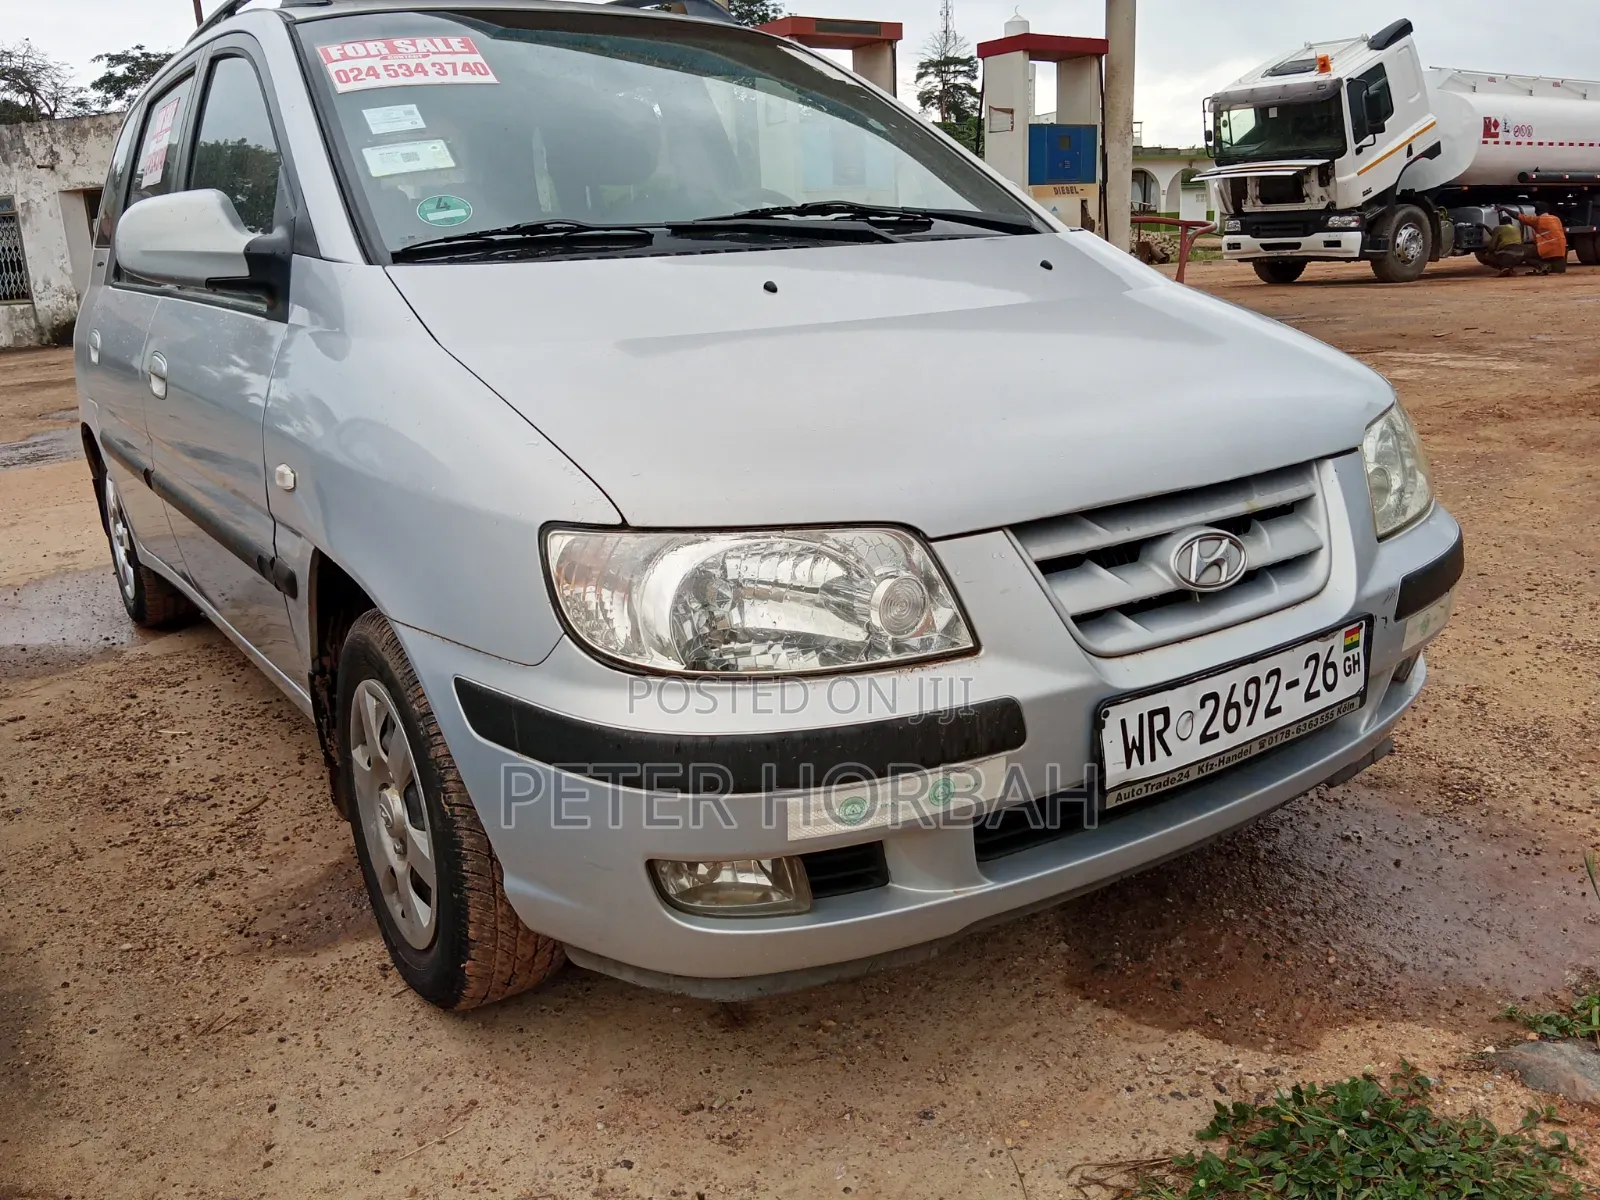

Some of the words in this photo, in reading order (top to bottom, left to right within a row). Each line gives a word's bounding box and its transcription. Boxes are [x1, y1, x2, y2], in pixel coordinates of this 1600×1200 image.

[327, 41, 390, 61] FOR
[393, 38, 470, 54] SALE
[334, 65, 381, 84] 024
[382, 62, 430, 79] 534
[430, 61, 490, 77] 3740
[1342, 652, 1361, 678] GH
[1120, 705, 1173, 770] WR
[1199, 645, 1339, 745] 2692-26
[1114, 769, 1191, 804] AutoTrade24
[1197, 745, 1252, 776] Kfz-Handel
[1336, 700, 1355, 717] Köln
